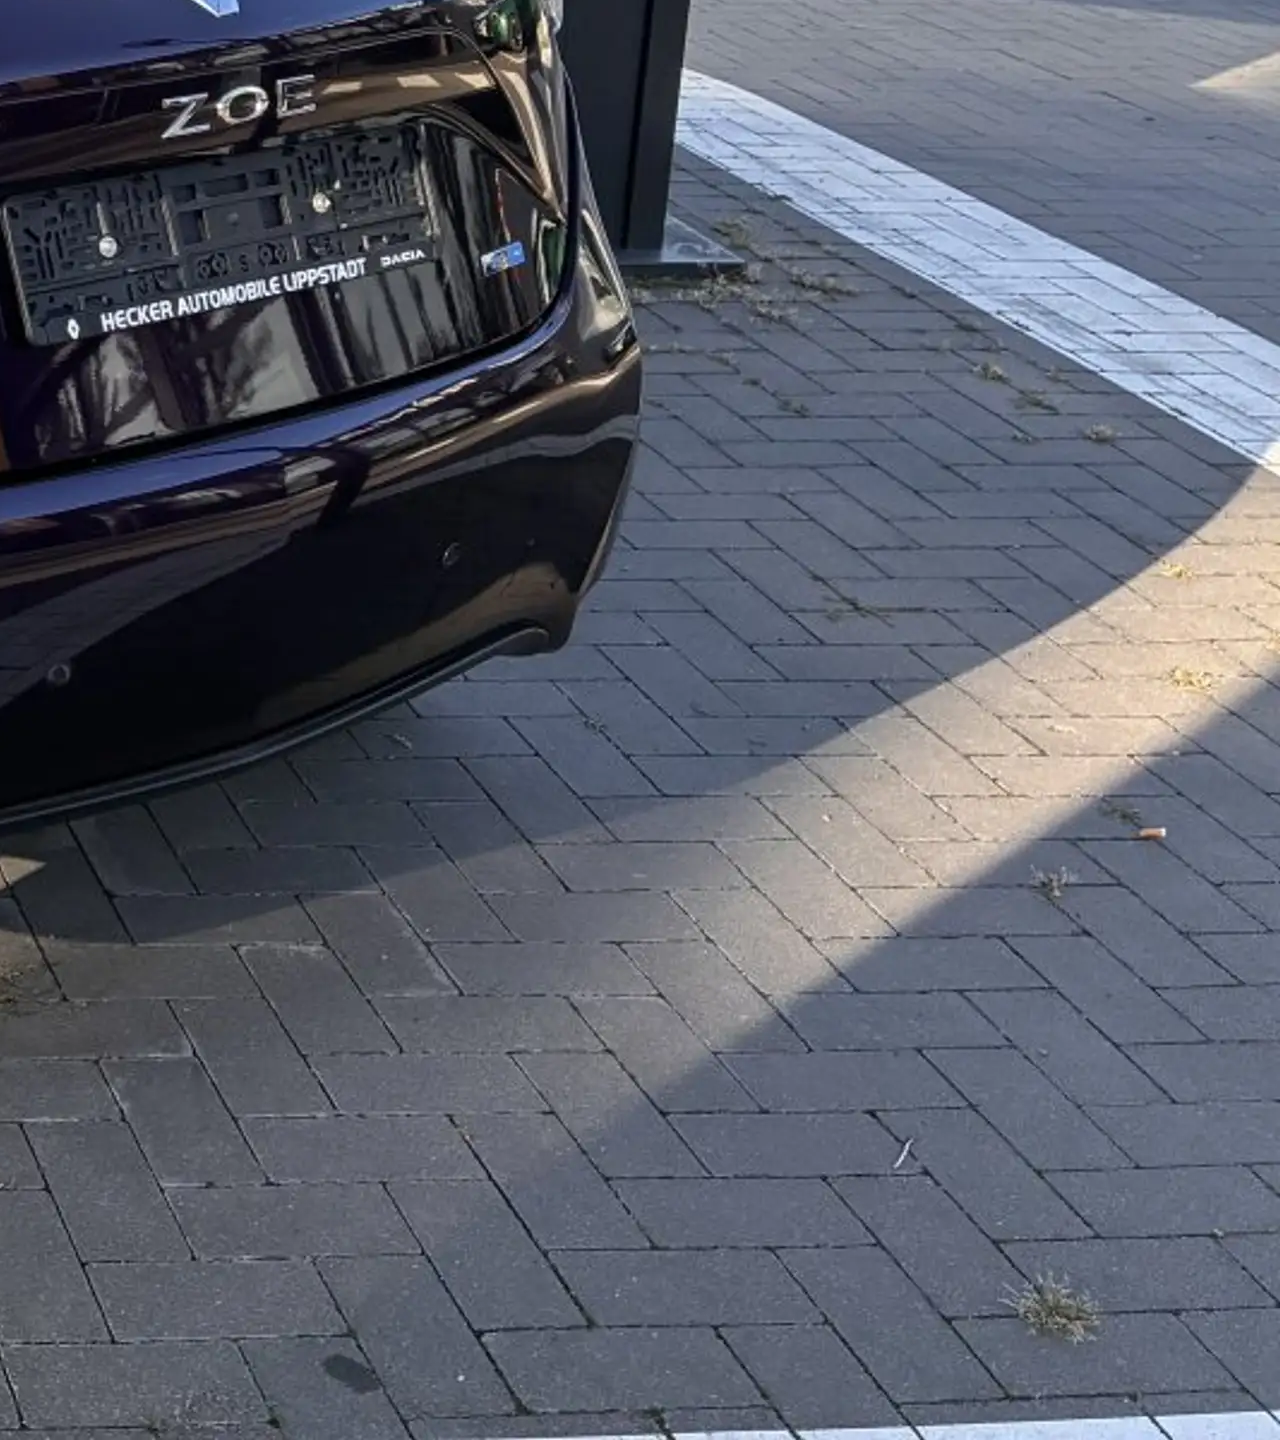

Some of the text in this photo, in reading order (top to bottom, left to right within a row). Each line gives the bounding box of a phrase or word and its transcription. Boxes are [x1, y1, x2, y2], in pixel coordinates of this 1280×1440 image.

[161, 73, 317, 140] ZOE
[101, 300, 174, 332] HECKER
[178, 274, 281, 316] AUTOMOBILE
[283, 257, 367, 293] LIPPSTADT
